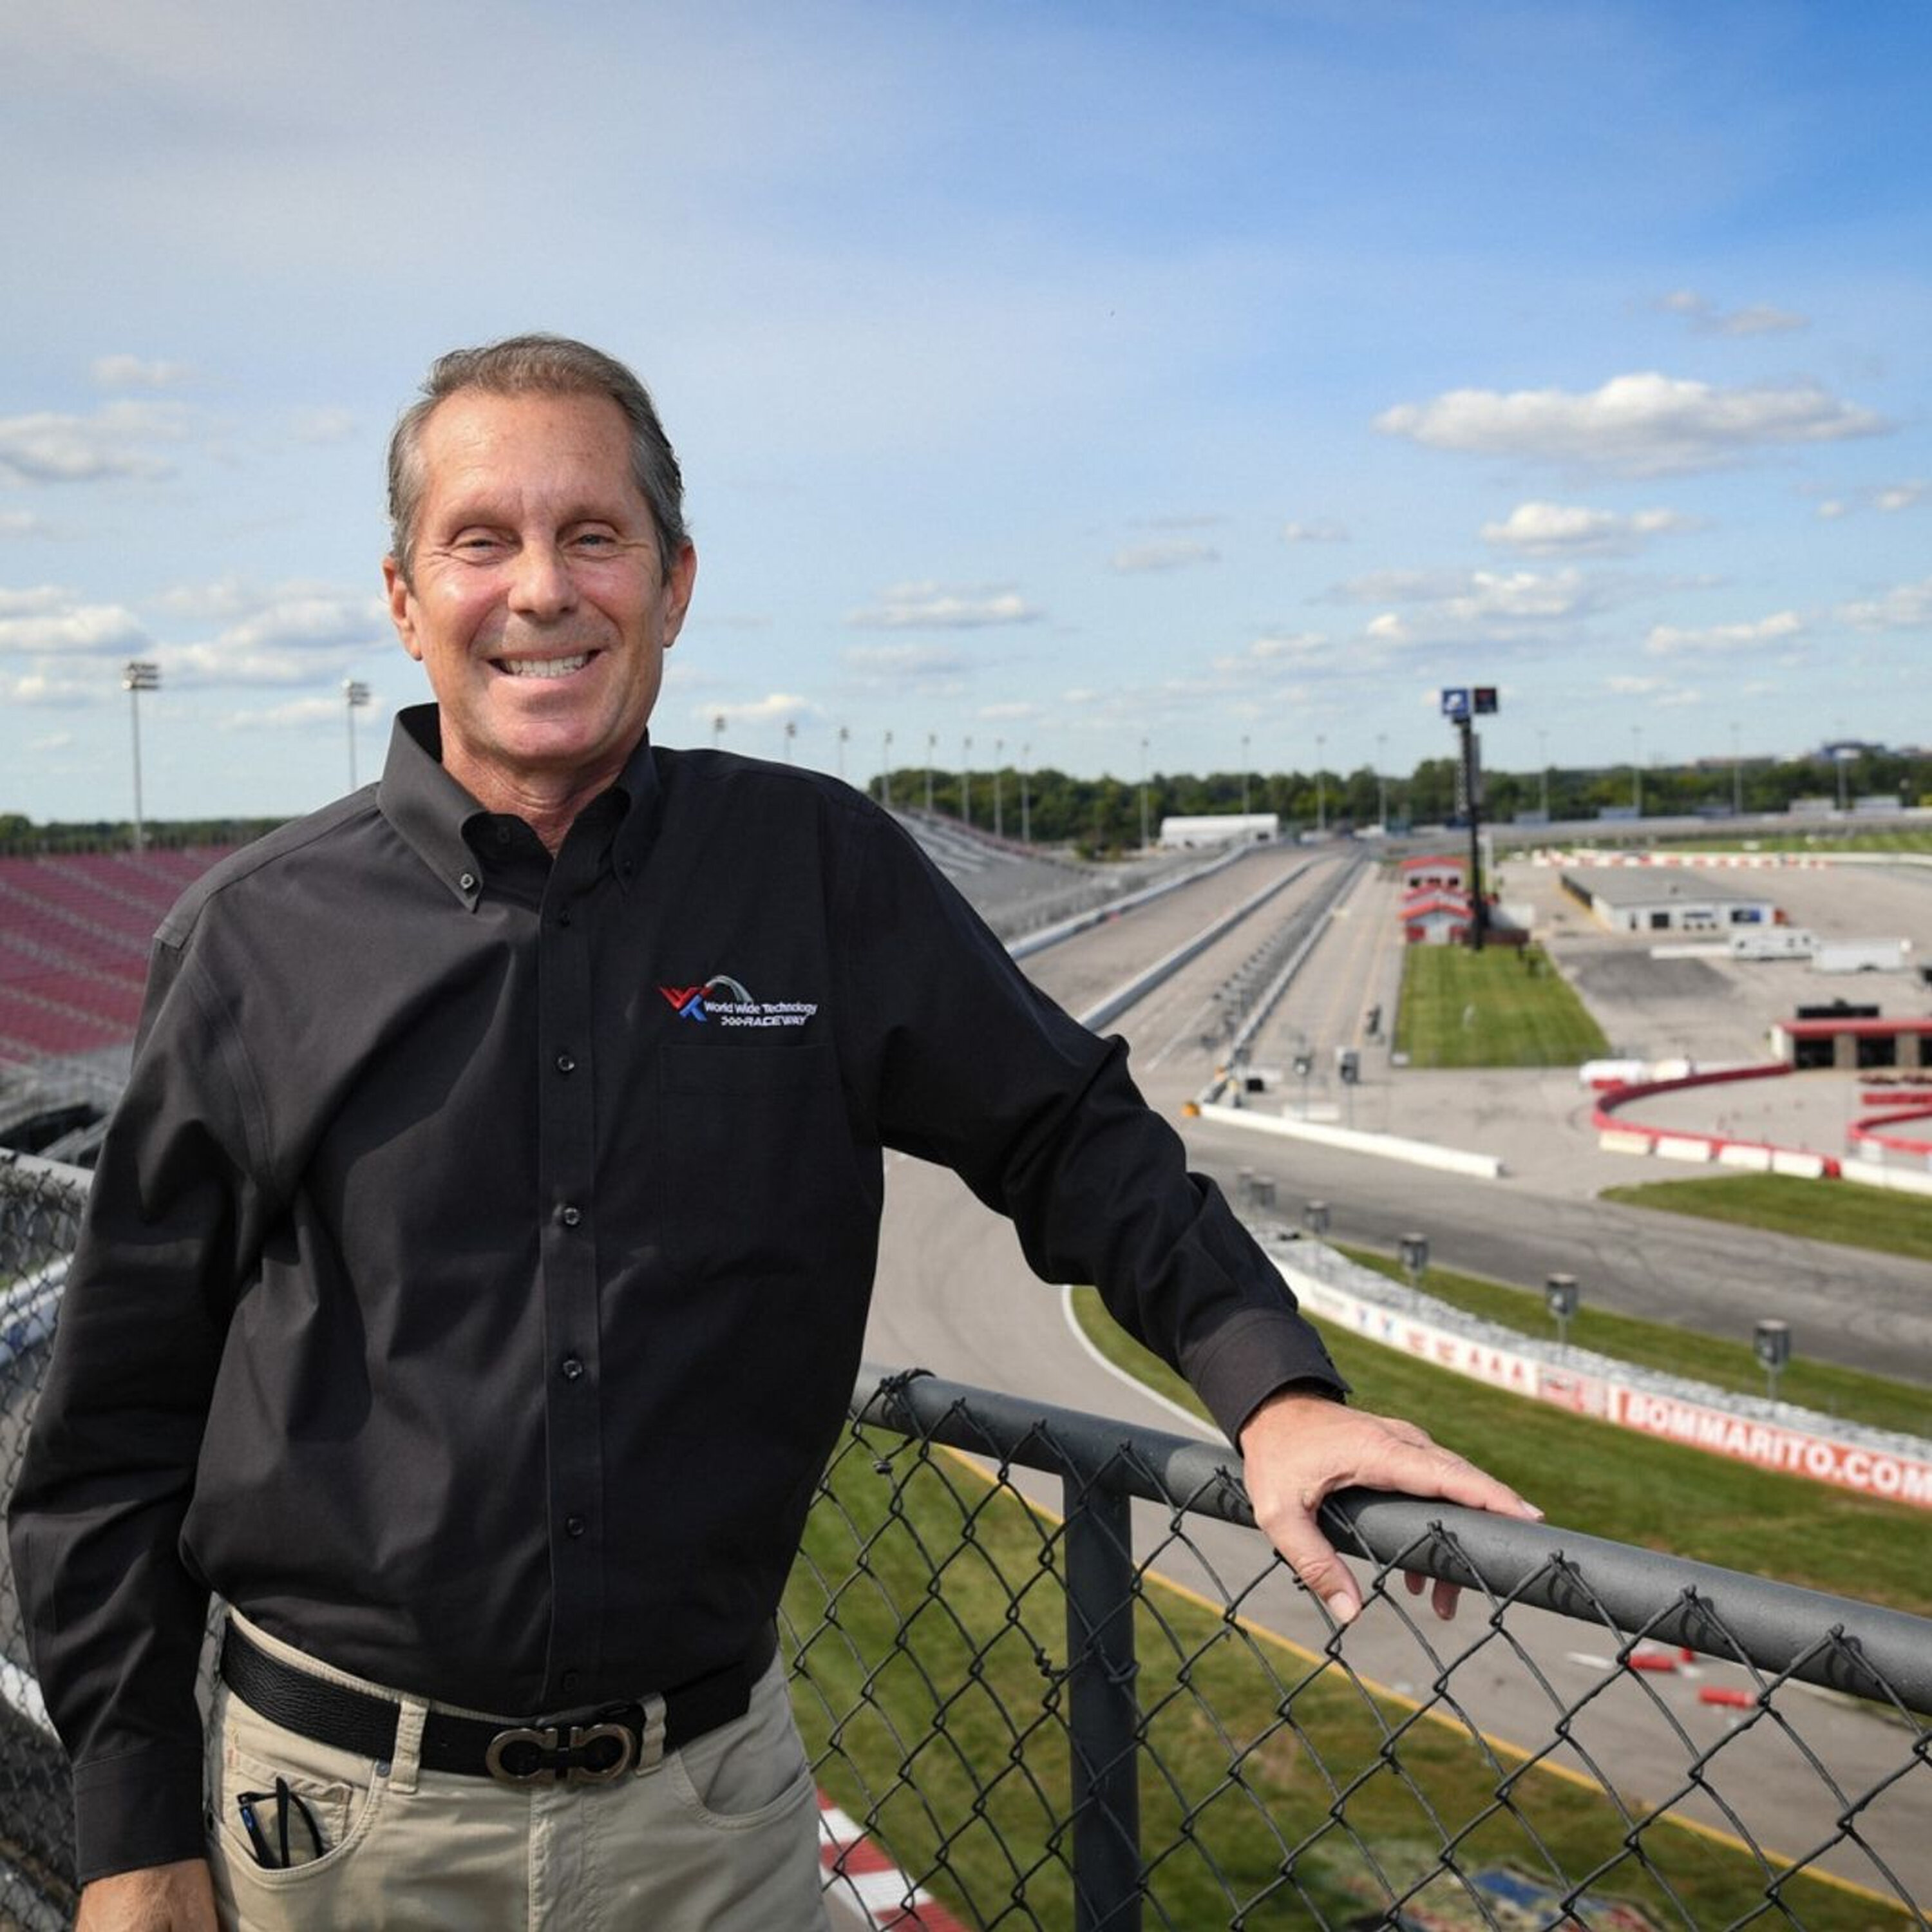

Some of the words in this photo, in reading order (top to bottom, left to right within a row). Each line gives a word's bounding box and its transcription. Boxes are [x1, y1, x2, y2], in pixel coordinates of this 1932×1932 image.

[704, 1001, 733, 1014] World
[735, 1002, 760, 1015] Wide
[762, 1002, 817, 1016] Technology
[1625, 1392, 1932, 1502] BOMMARITO.COM
